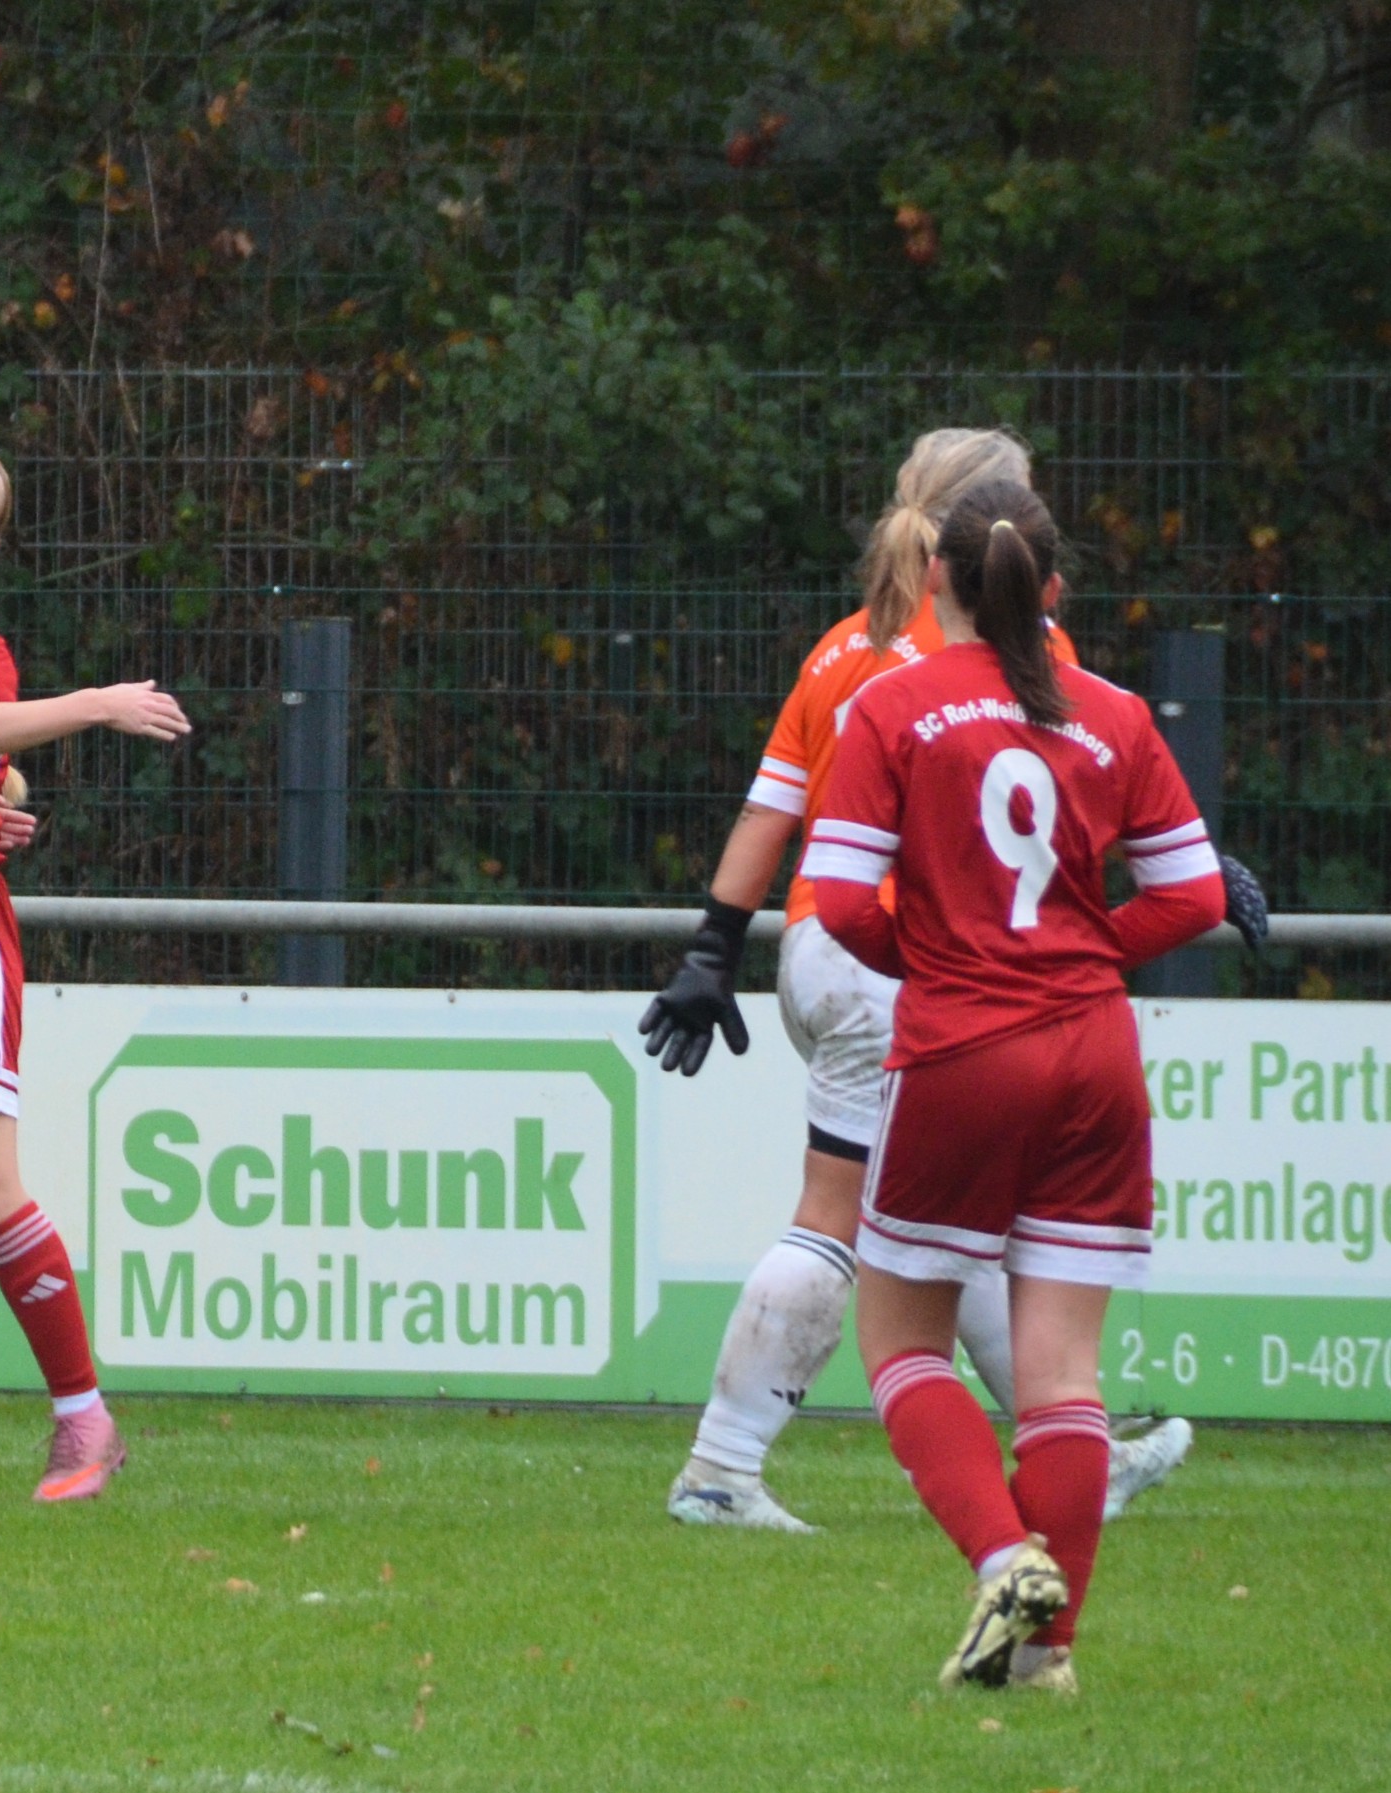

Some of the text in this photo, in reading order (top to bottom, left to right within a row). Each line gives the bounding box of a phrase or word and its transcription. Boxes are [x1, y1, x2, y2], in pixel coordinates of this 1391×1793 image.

[914, 712, 944, 742] SC
[941, 698, 1027, 726] Rot-Weiß
[980, 747, 1058, 928] 9
[1250, 1041, 1391, 1123] Part
[121, 1108, 586, 1231] Schunk
[120, 1250, 585, 1346] Mobilraum
